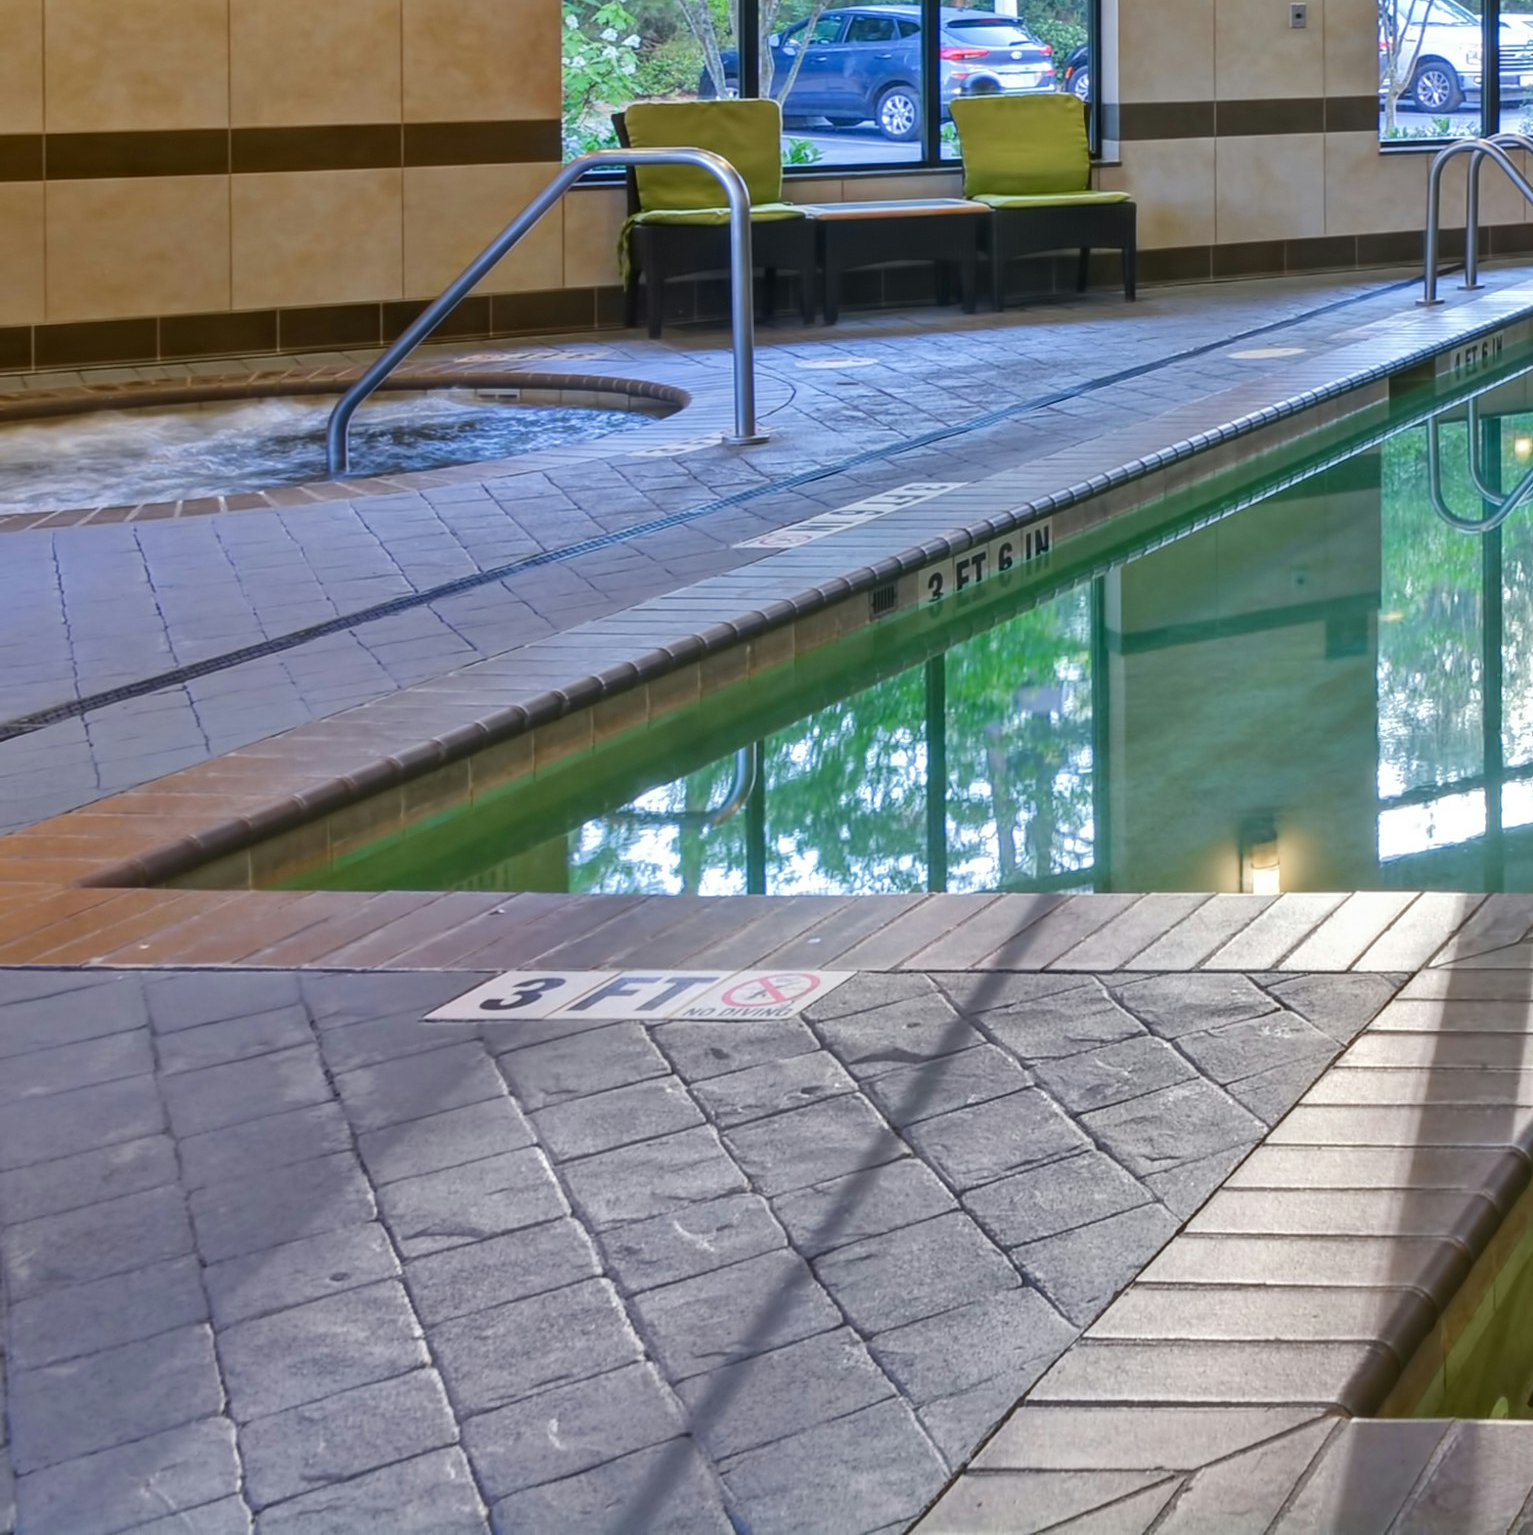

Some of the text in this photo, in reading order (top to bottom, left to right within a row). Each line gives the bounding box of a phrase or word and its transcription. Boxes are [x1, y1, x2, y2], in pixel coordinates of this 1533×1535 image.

[956, 551, 986, 592] FT
[998, 542, 1012, 572] 6
[1025, 525, 1050, 561] IN
[480, 977, 720, 1011] 3 FT
[681, 1007, 790, 1018] NO DIVING
